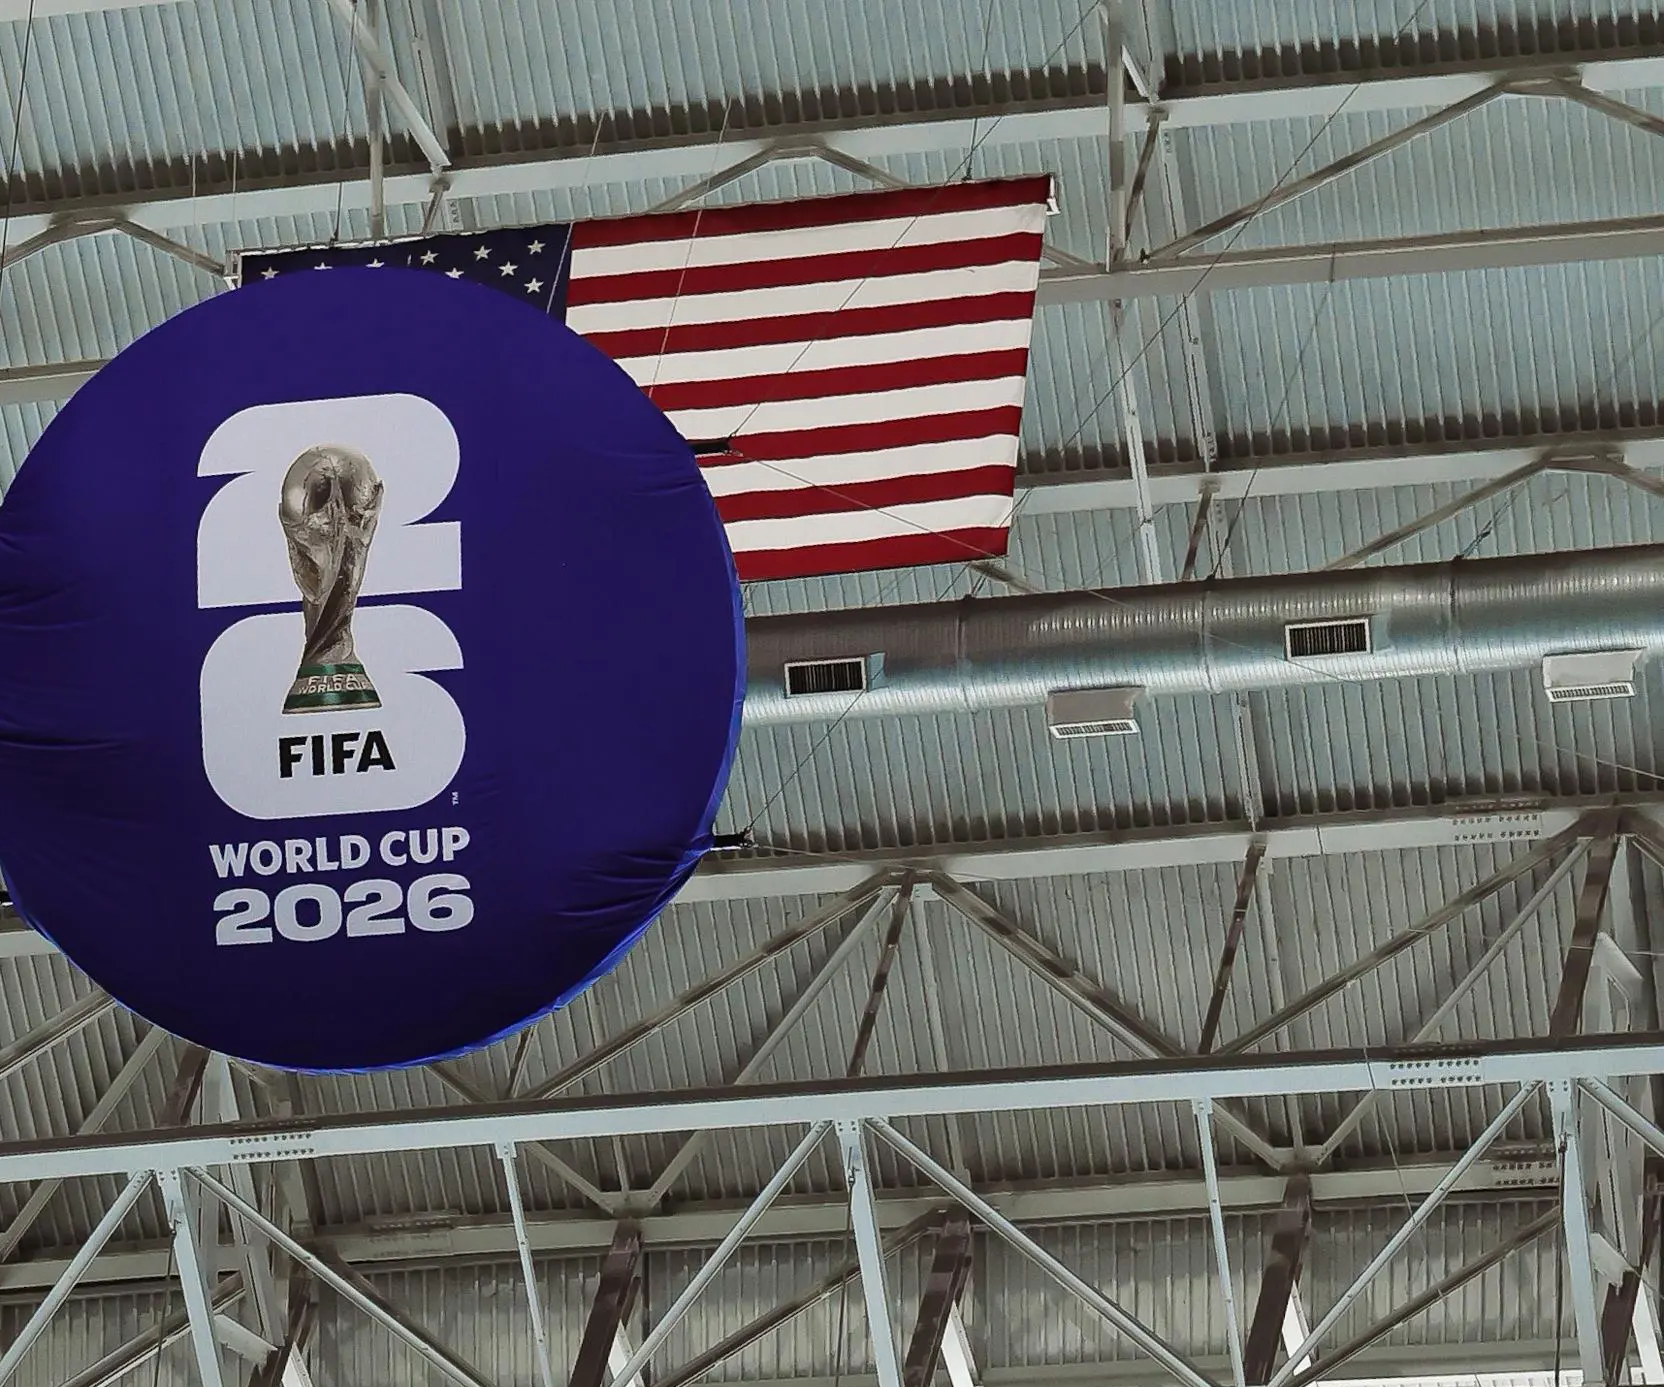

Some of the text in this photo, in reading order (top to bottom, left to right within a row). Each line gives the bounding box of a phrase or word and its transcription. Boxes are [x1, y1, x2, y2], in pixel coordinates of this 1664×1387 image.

[308, 673, 359, 686] FIFA
[278, 730, 396, 779] FIFA
[208, 826, 471, 878] WORLD CUP
[213, 873, 475, 946] 2026
